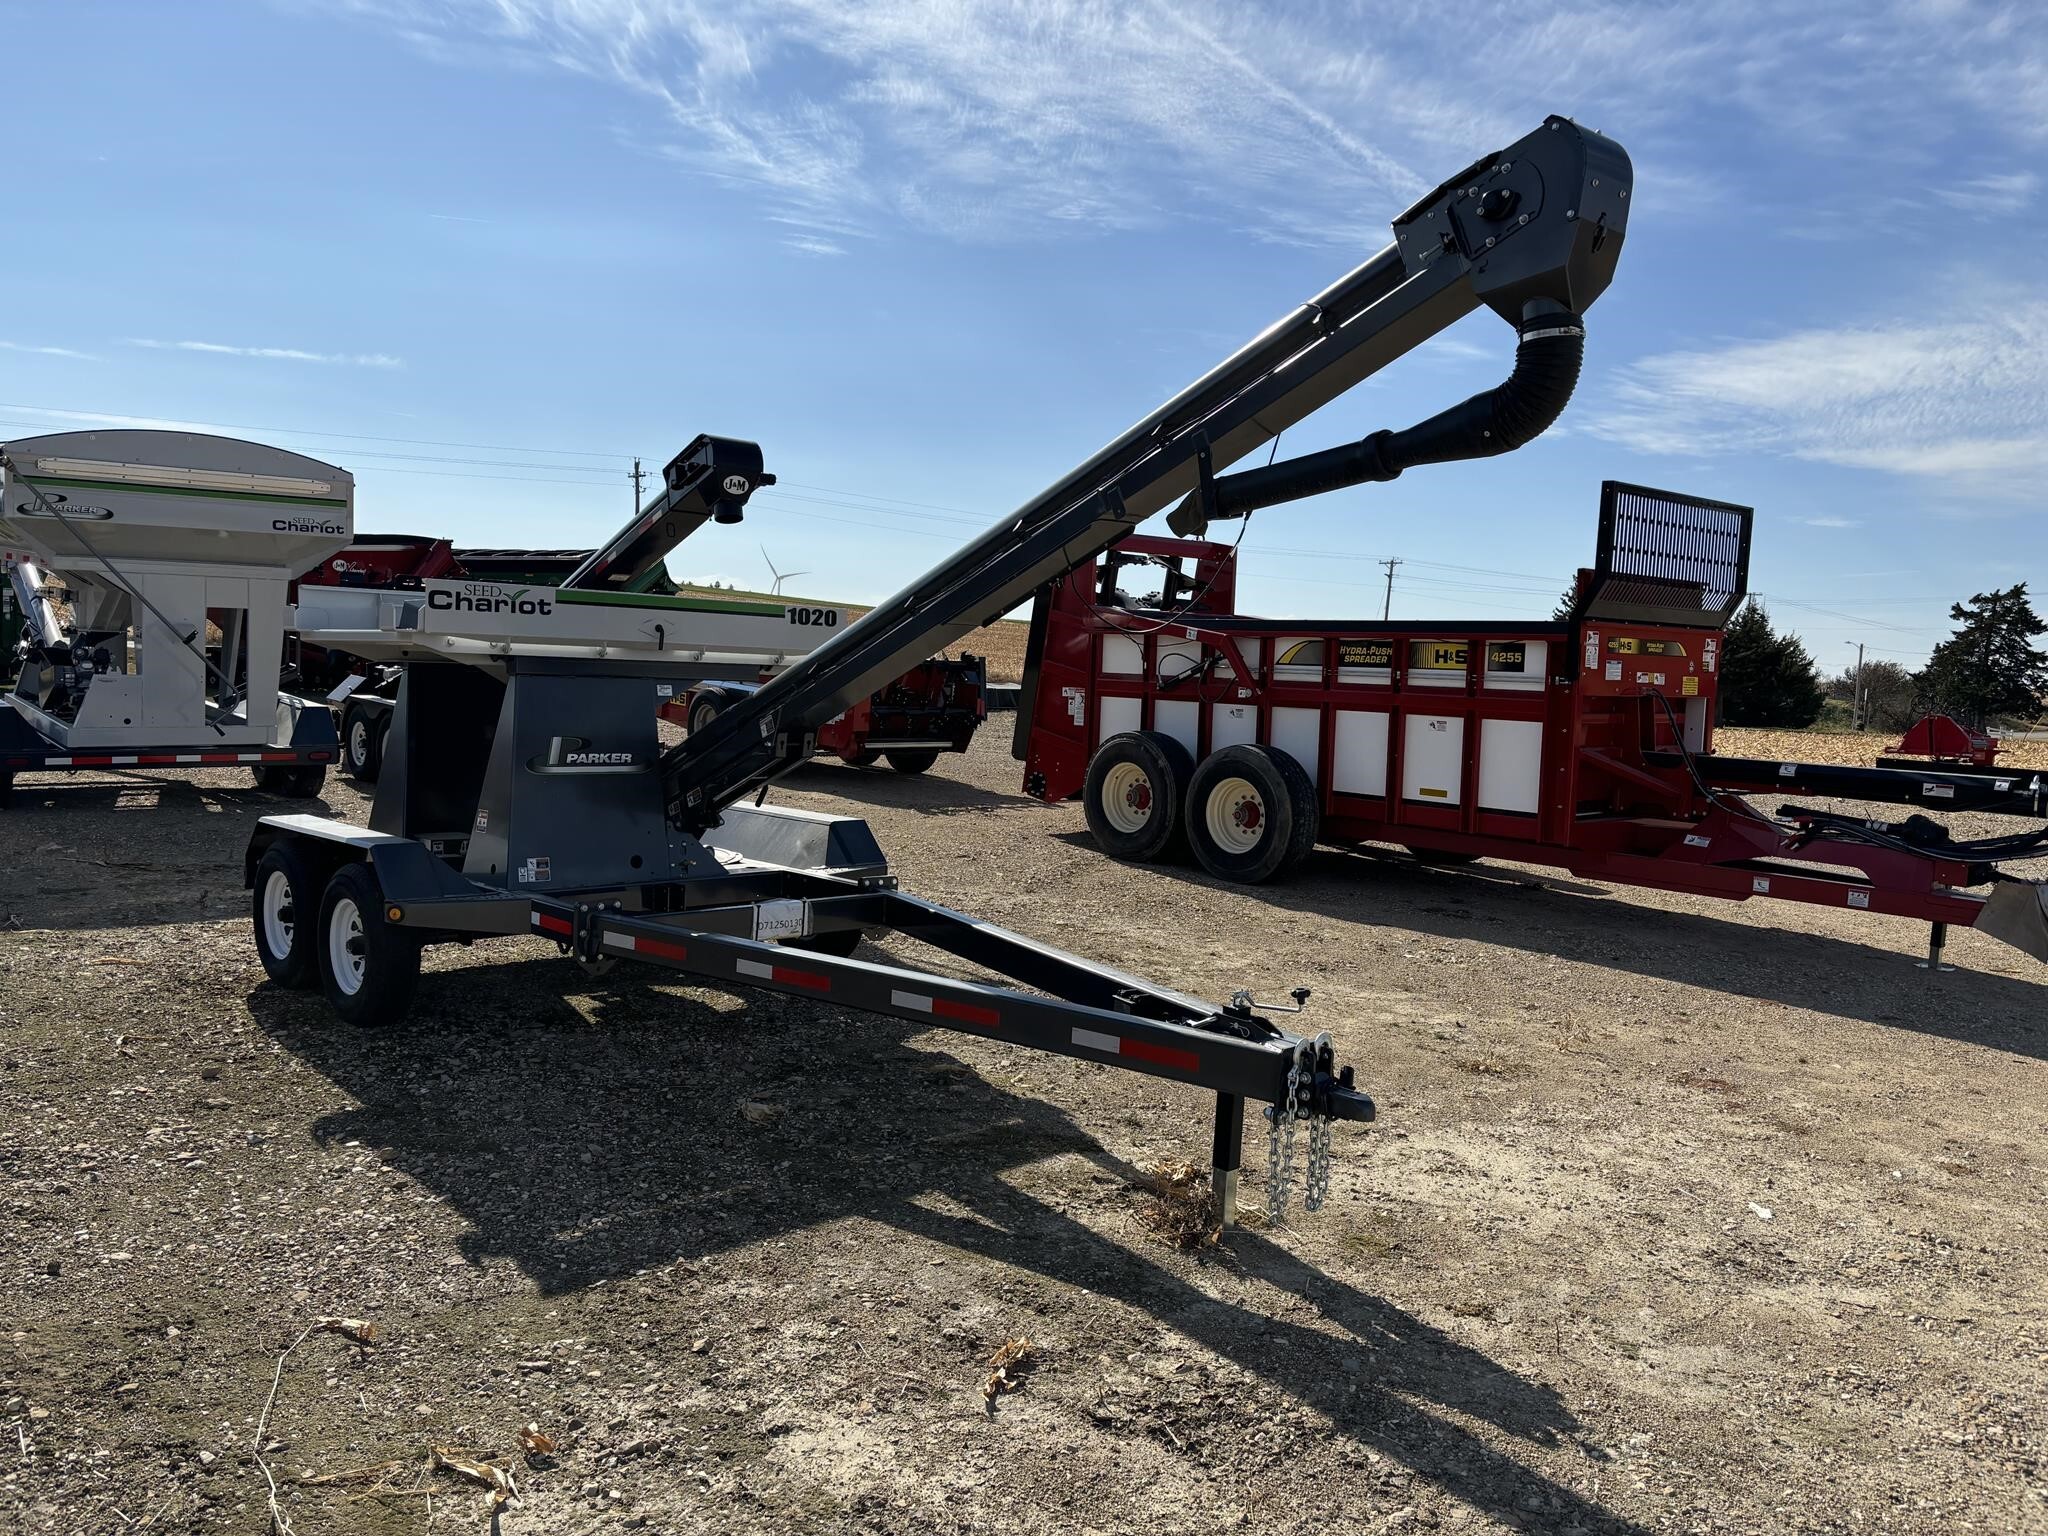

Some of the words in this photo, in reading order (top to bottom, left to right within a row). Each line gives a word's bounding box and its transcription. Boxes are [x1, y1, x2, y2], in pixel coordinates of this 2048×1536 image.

[725, 478, 746, 492] J&M
[272, 519, 345, 535] Chariot
[292, 517, 315, 525] SEED
[464, 584, 502, 597] SEED
[428, 589, 552, 616] Chariot
[787, 608, 837, 627] 1020
[1344, 655, 1388, 664] SPREADER
[1434, 649, 1468, 665] H&S
[1491, 652, 1522, 663] 4255
[566, 753, 632, 764] PARKER
